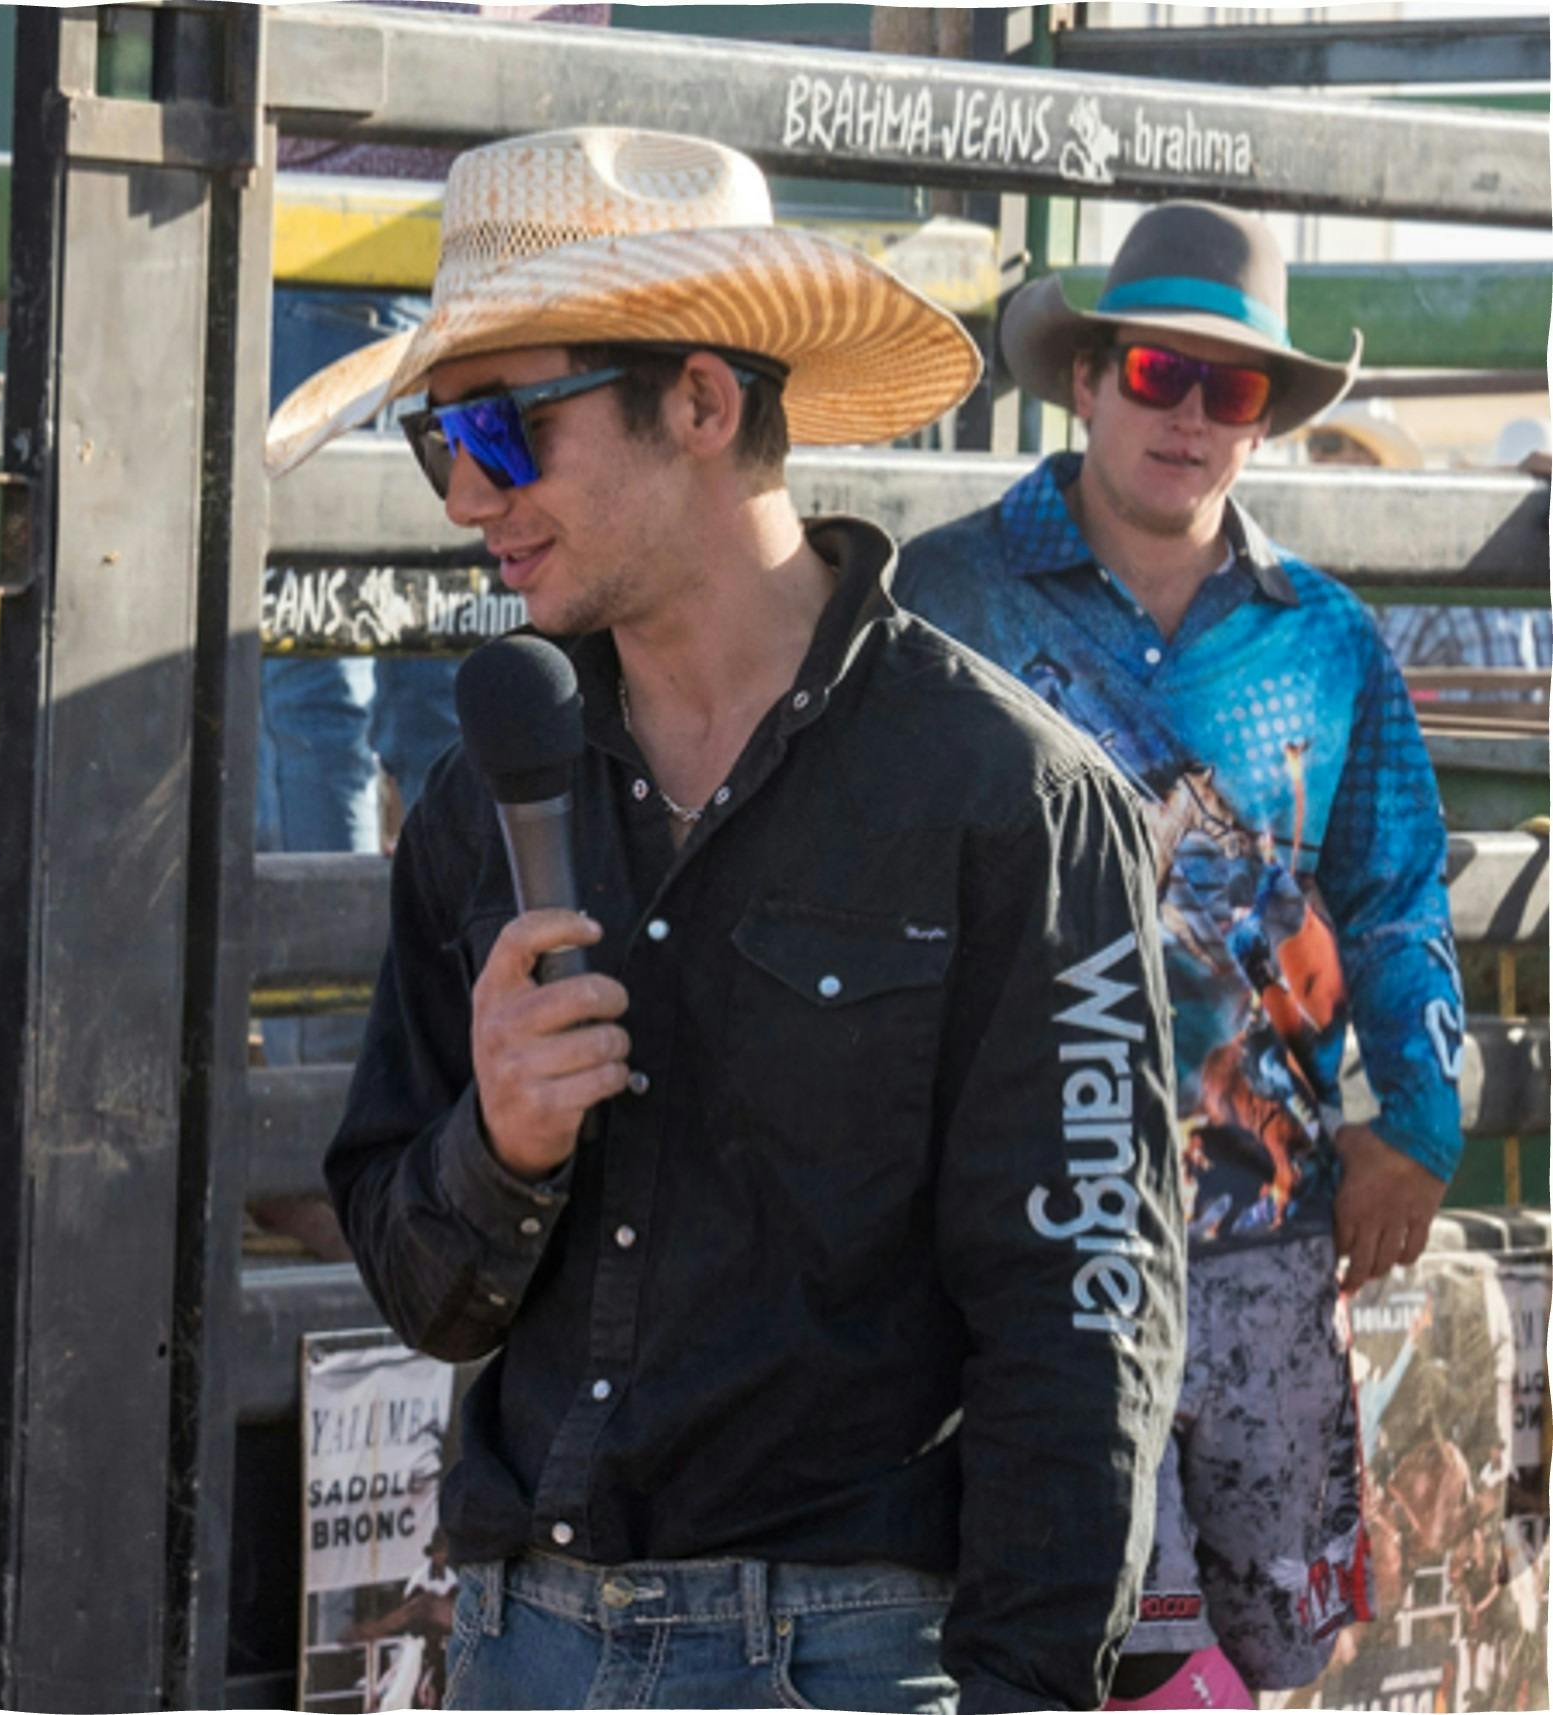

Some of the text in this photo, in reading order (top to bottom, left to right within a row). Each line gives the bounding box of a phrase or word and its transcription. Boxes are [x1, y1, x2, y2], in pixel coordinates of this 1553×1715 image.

[782, 73, 934, 157] BRAHMA
[942, 86, 1054, 164] JEANS
[1134, 105, 1251, 176] brahma
[1026, 930, 1154, 1342] Wrangler
[311, 1507, 416, 1551] BRONC
